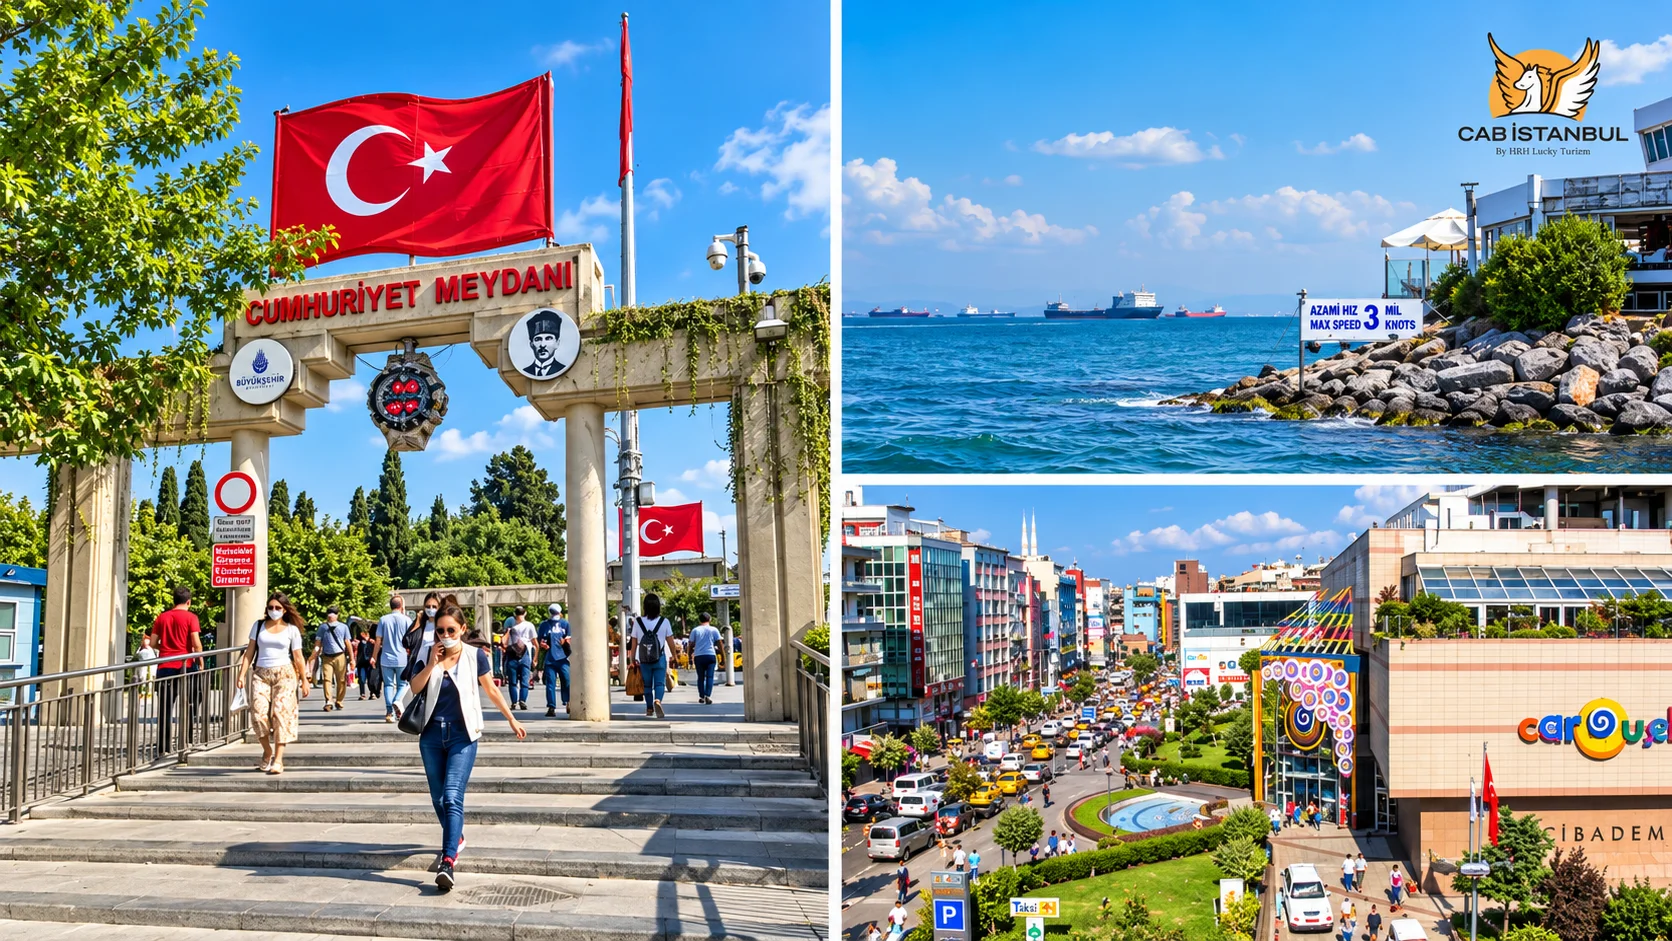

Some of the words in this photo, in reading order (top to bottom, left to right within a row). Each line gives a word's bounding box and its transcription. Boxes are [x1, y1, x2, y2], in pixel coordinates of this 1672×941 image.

[245, 280, 421, 326] CUMHURİYET
[435, 261, 573, 304] MEYDANI
[1310, 302, 1340, 316] AZAMİ
[1342, 305, 1359, 316] HIZ
[1385, 302, 1403, 316] MİL
[1363, 304, 1380, 330] 3
[1310, 319, 1331, 330] MAX
[1332, 319, 1361, 330] SPEED
[1385, 319, 1416, 330] KNOTS
[942, 905, 957, 925] P
